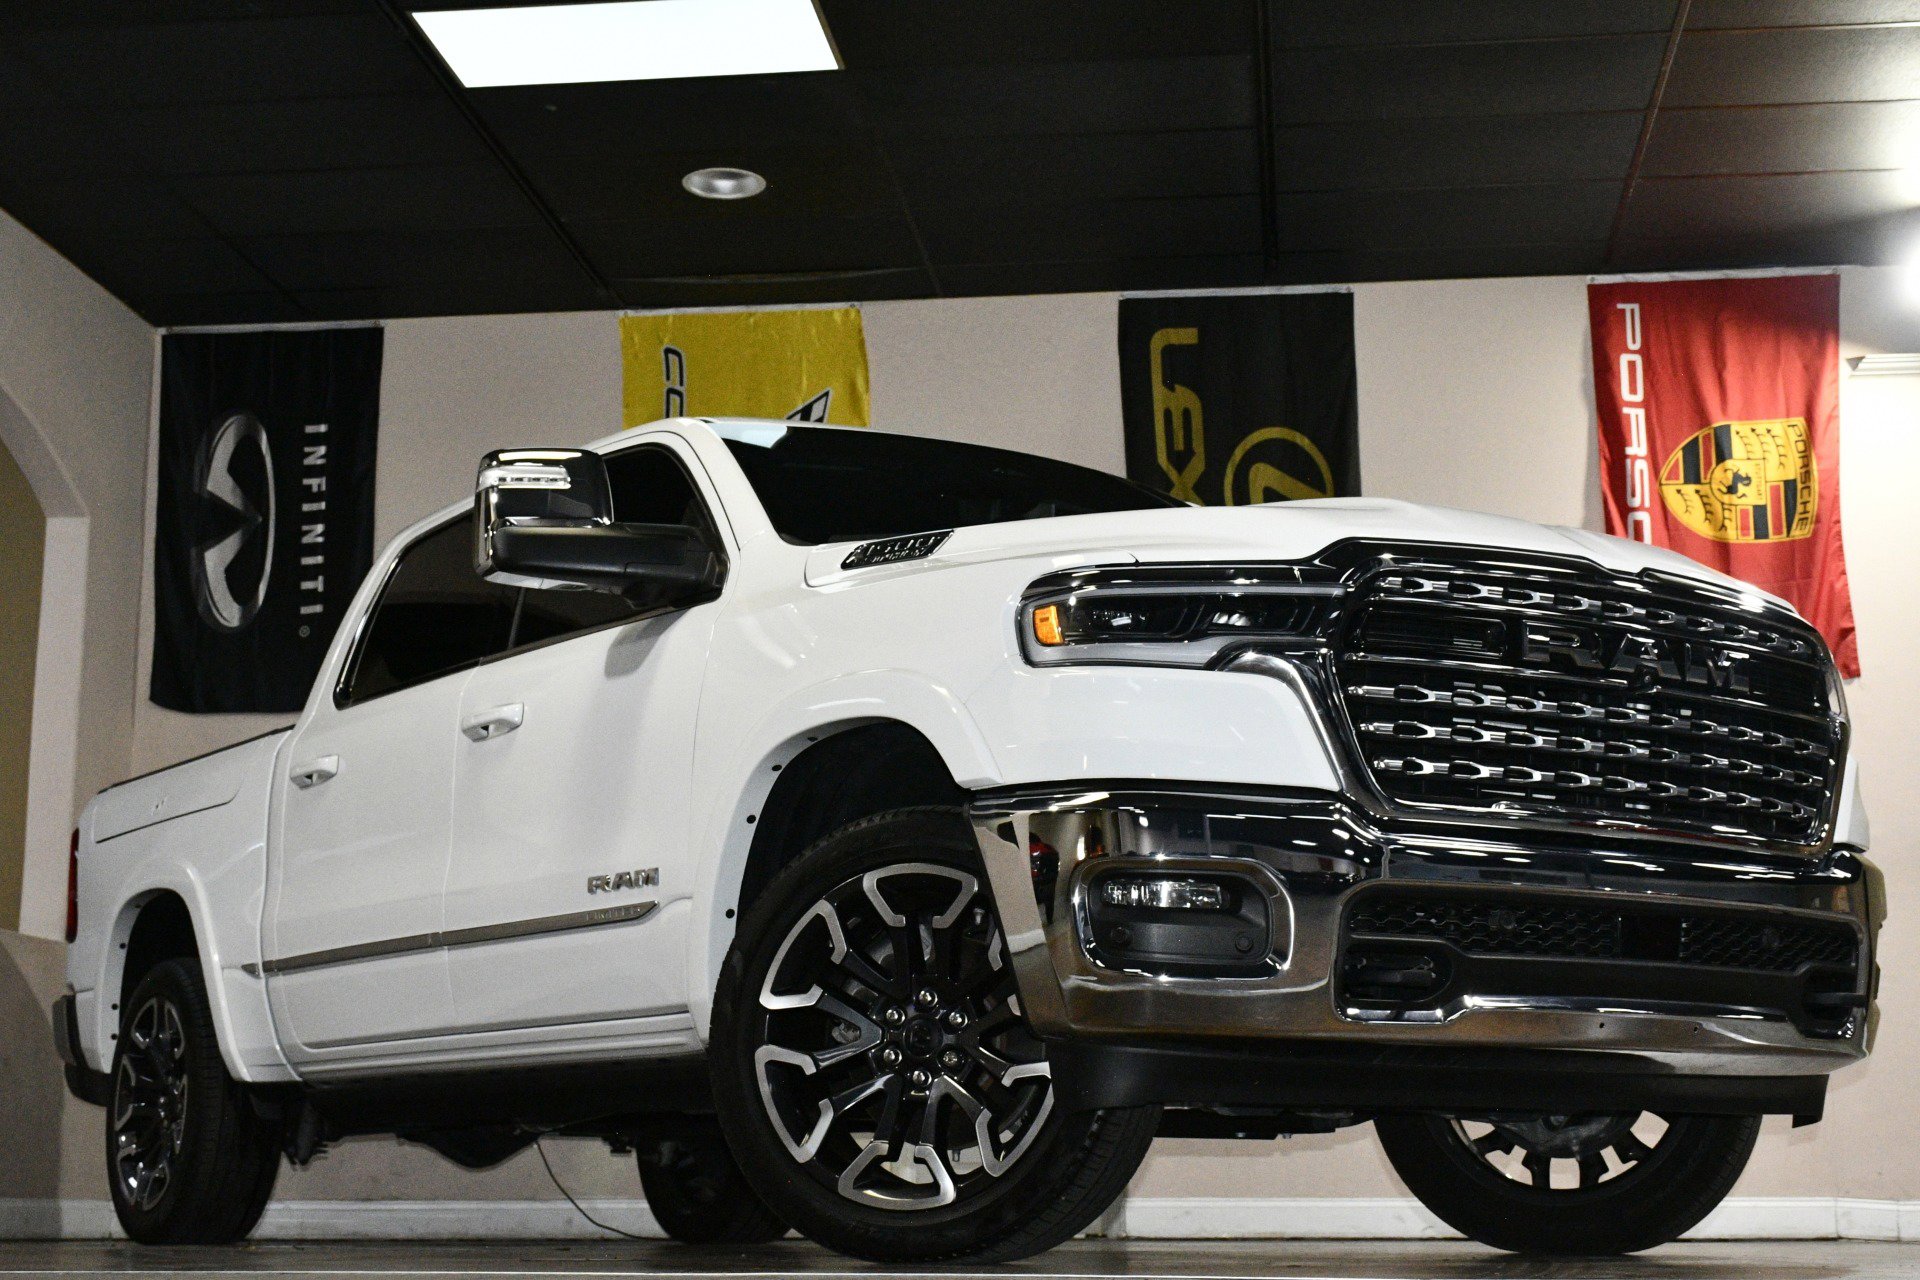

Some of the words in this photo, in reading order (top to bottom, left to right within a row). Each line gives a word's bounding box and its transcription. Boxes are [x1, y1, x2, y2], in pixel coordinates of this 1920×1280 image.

[300, 423, 329, 616] INFINITI
[1786, 424, 1812, 532] PORSCHE
[1522, 619, 1751, 694] RAM
[587, 867, 660, 895] RAM
